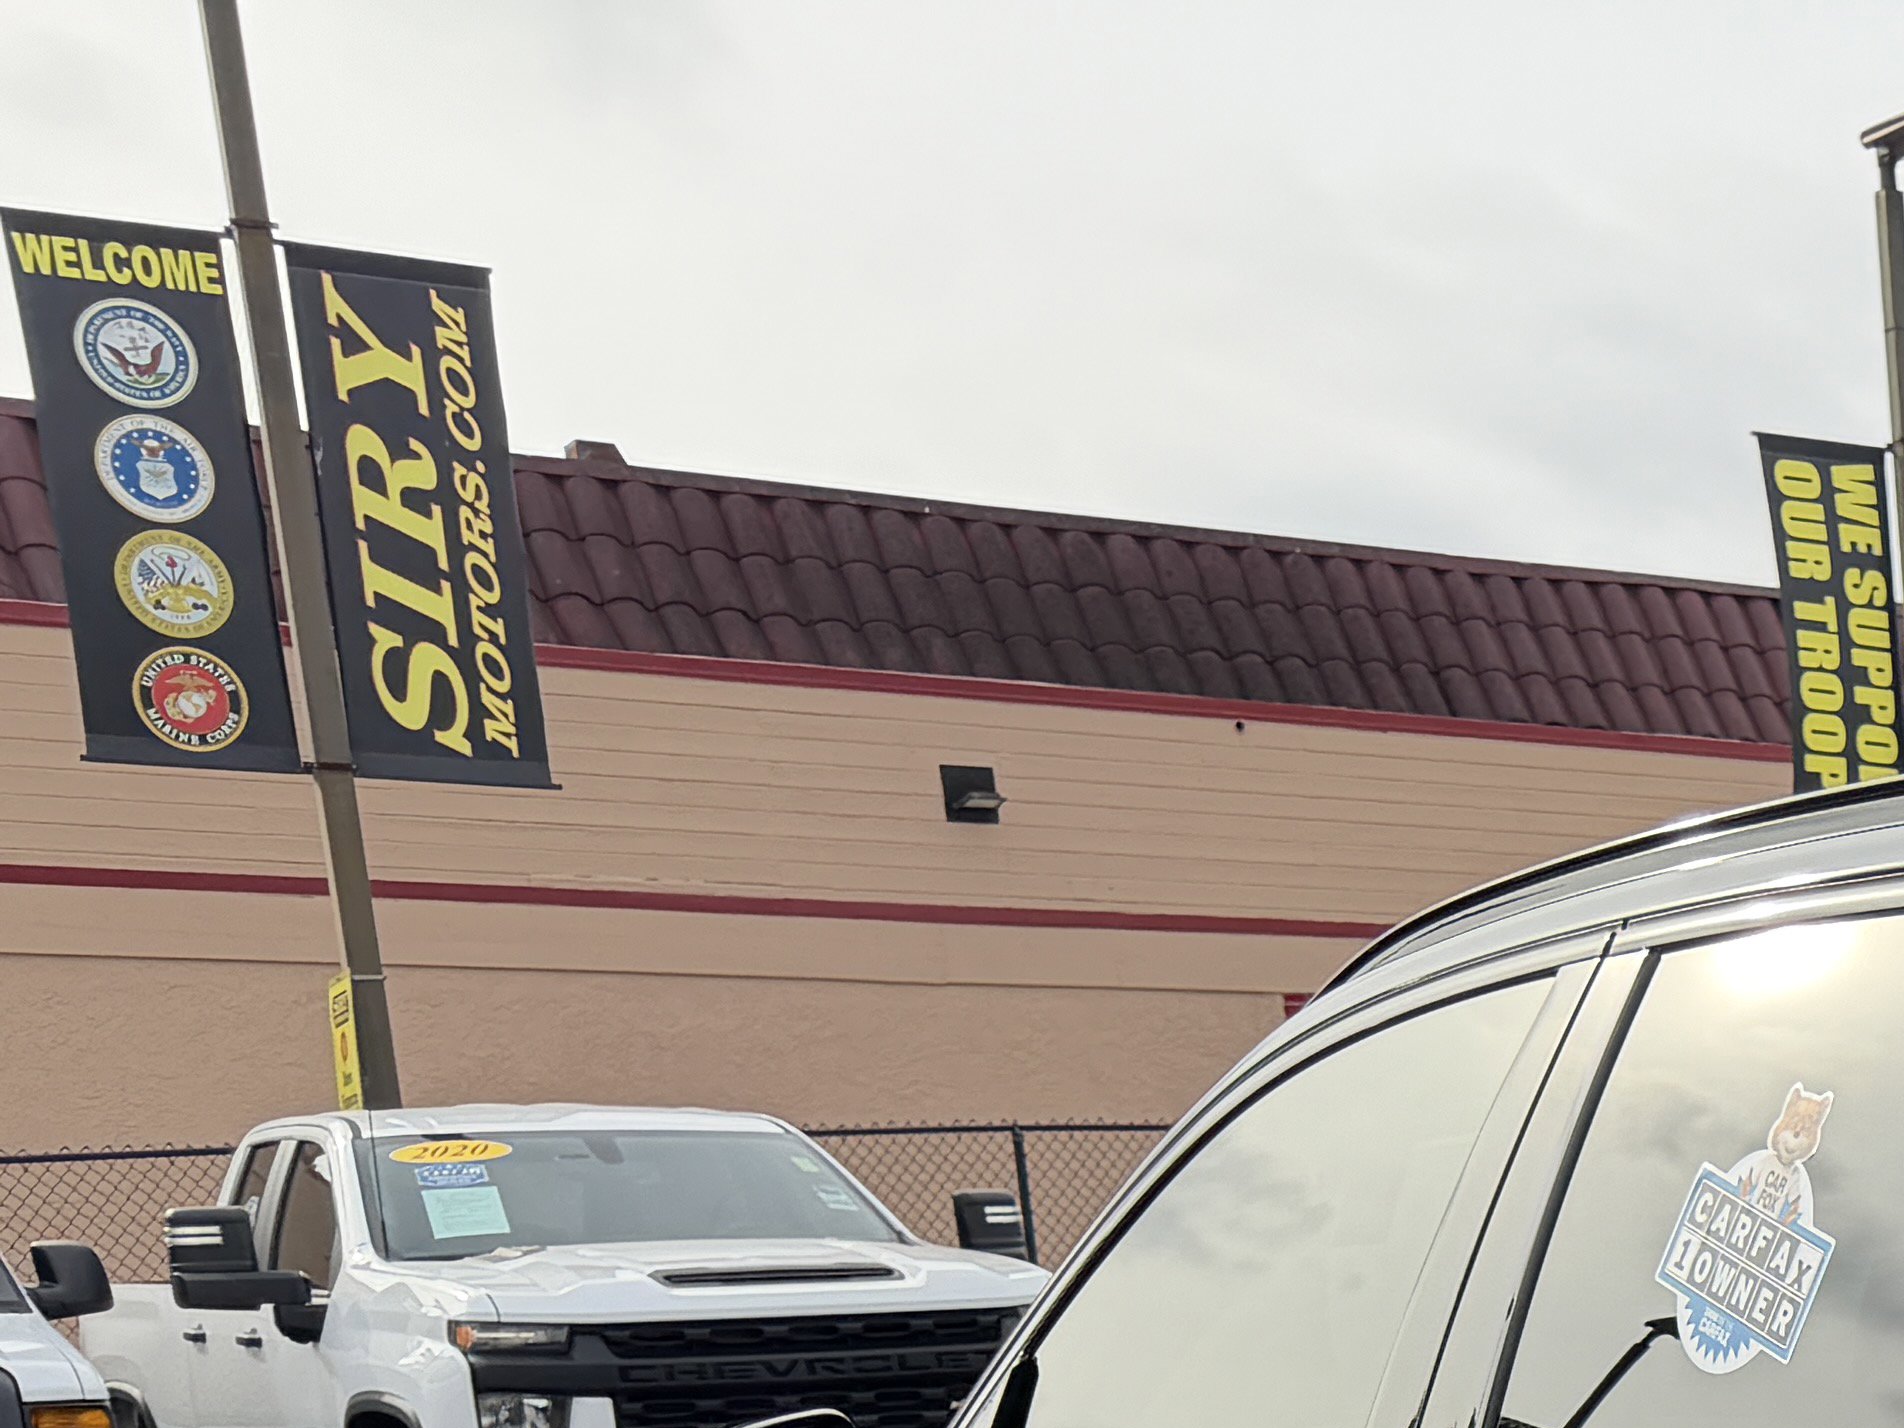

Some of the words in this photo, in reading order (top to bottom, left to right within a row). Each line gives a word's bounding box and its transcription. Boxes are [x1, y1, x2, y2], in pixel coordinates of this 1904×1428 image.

[11, 231, 224, 295] WELCOME
[320, 269, 474, 758] SIRY
[428, 287, 520, 759] MOTORS.COM
[1773, 458, 1833, 582] OUR
[1830, 463, 1884, 557] WE
[141, 653, 185, 688] UNITED
[188, 655, 237, 693] STATES
[146, 708, 201, 746] MARINE
[205, 711, 240, 745] CORPS
[411, 1142, 490, 1161] 2020
[1764, 1169, 1789, 1194] CAR
[1756, 1189, 1781, 1215] FOX
[1693, 1191, 1813, 1294] CARFAX
